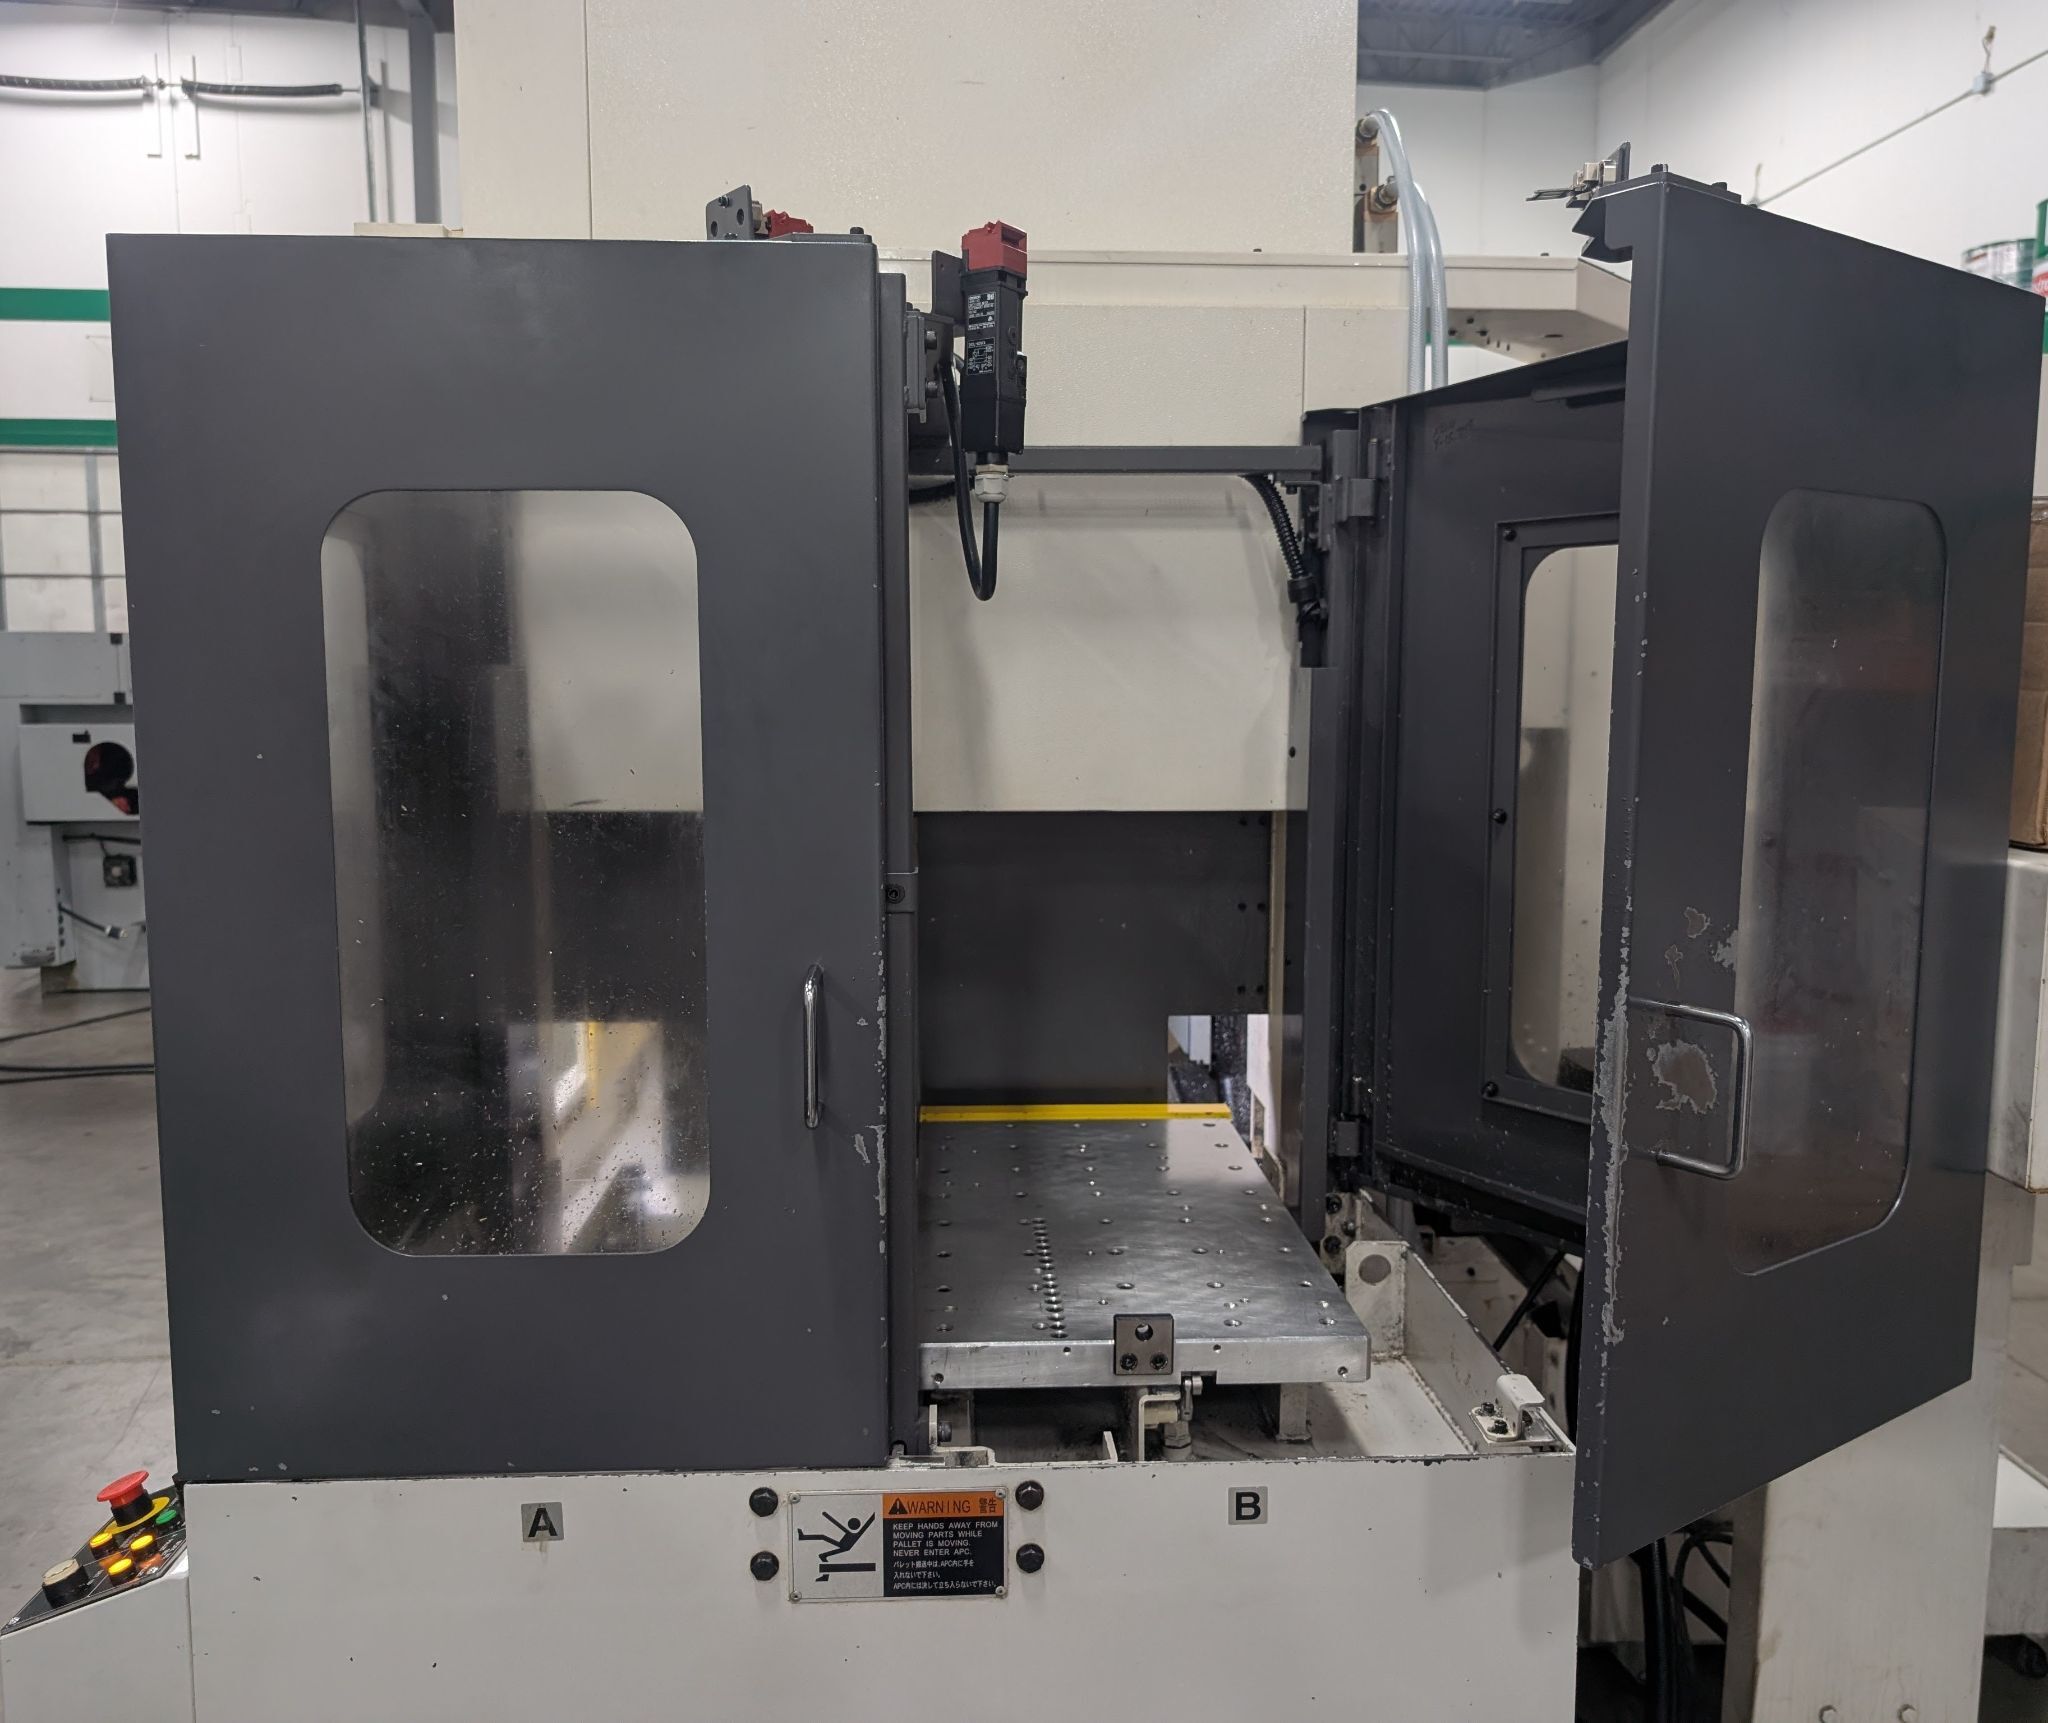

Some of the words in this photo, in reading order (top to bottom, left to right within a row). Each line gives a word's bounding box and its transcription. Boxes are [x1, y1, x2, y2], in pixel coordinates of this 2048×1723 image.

[908, 1498, 971, 1514] WARNING
[979, 1498, 997, 1514] 警告
[1236, 1491, 1261, 1521] B
[528, 1507, 558, 1538] A
[893, 1522, 914, 1530] KEEP
[917, 1522, 945, 1530] HANDS
[948, 1521, 972, 1529] AWAY
[893, 1531, 924, 1539] MOVING
[893, 1540, 922, 1548] PALLET
[938, 1539, 971, 1547] MOVING.
[893, 1549, 920, 1557] NEVER
[923, 1548, 950, 1556] ENTER
